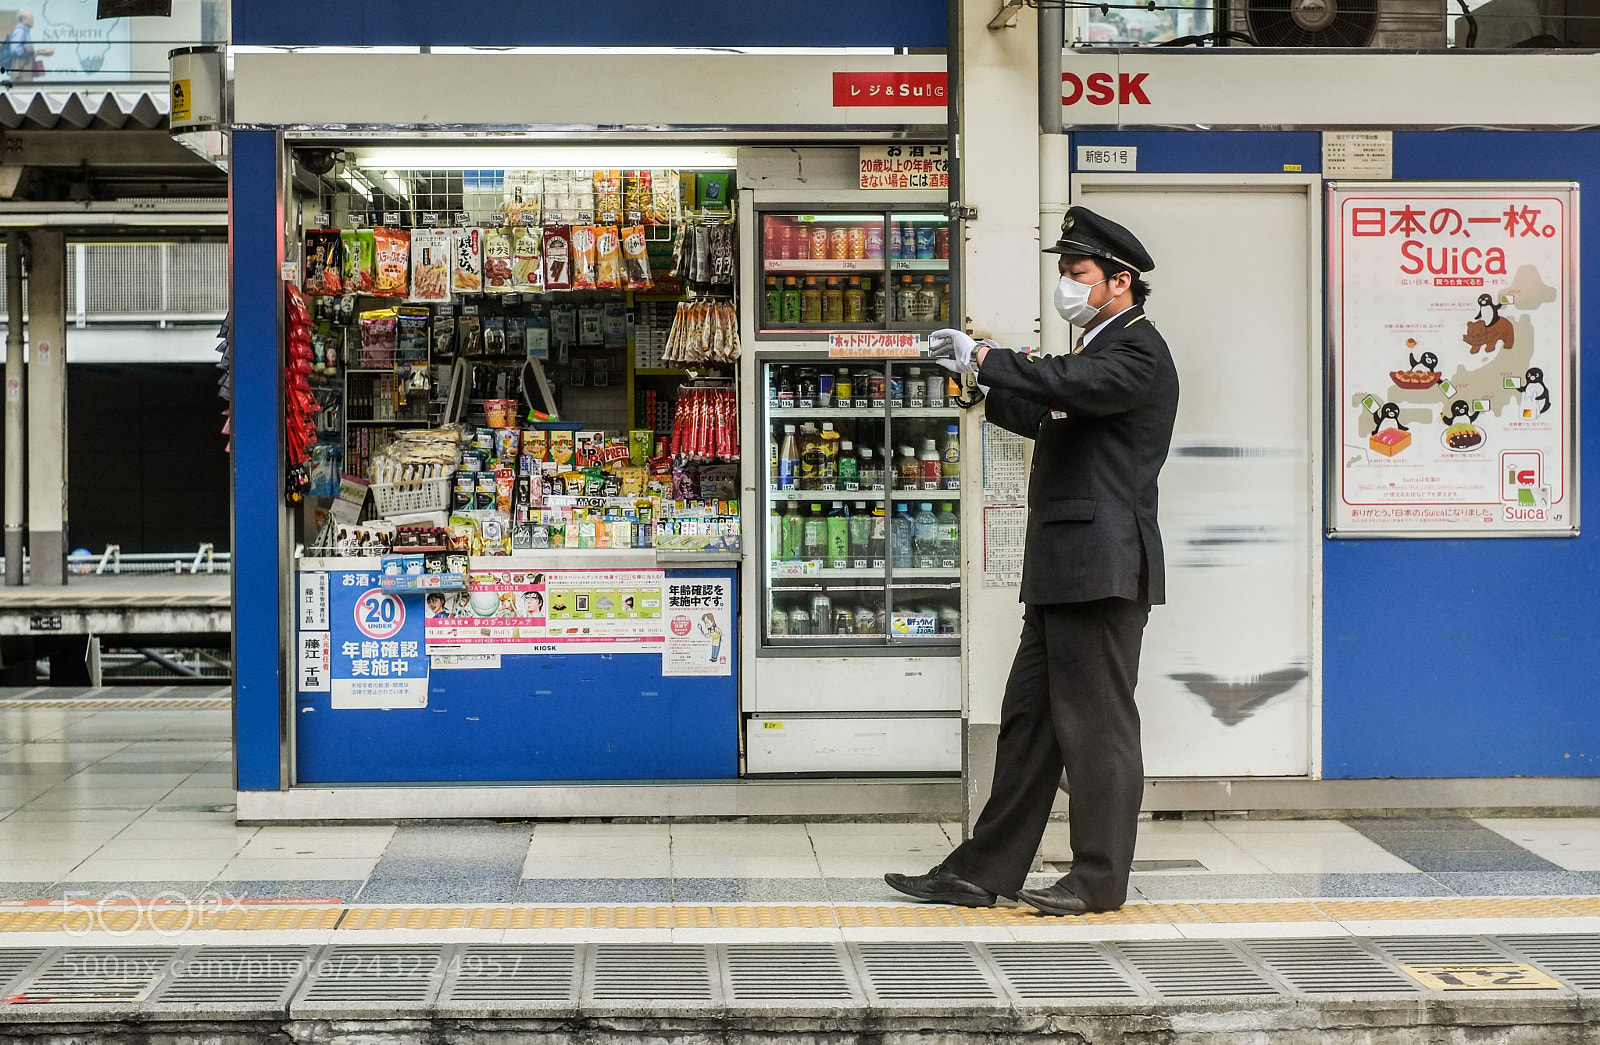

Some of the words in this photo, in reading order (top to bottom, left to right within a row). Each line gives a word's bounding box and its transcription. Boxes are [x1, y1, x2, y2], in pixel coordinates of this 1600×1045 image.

[887, 146, 948, 158] お酒コ
[1085, 150, 1128, 164] 新宿51号
[1352, 204, 1556, 239] 日本の、一枚。
[1400, 240, 1507, 275] Suica
[835, 334, 914, 347] ホットドリンクあります
[605, 446, 630, 461] PRETZ
[1351, 508, 1493, 518] ありがとう。「日本の」Suicaになりました。
[1505, 506, 1544, 520] Suica
[669, 584, 724, 596] 年齢確認を
[669, 596, 724, 607] 実施中です。
[365, 598, 396, 623] 20
[342, 640, 419, 659] 年齢確認
[351, 658, 409, 677] 実施中
